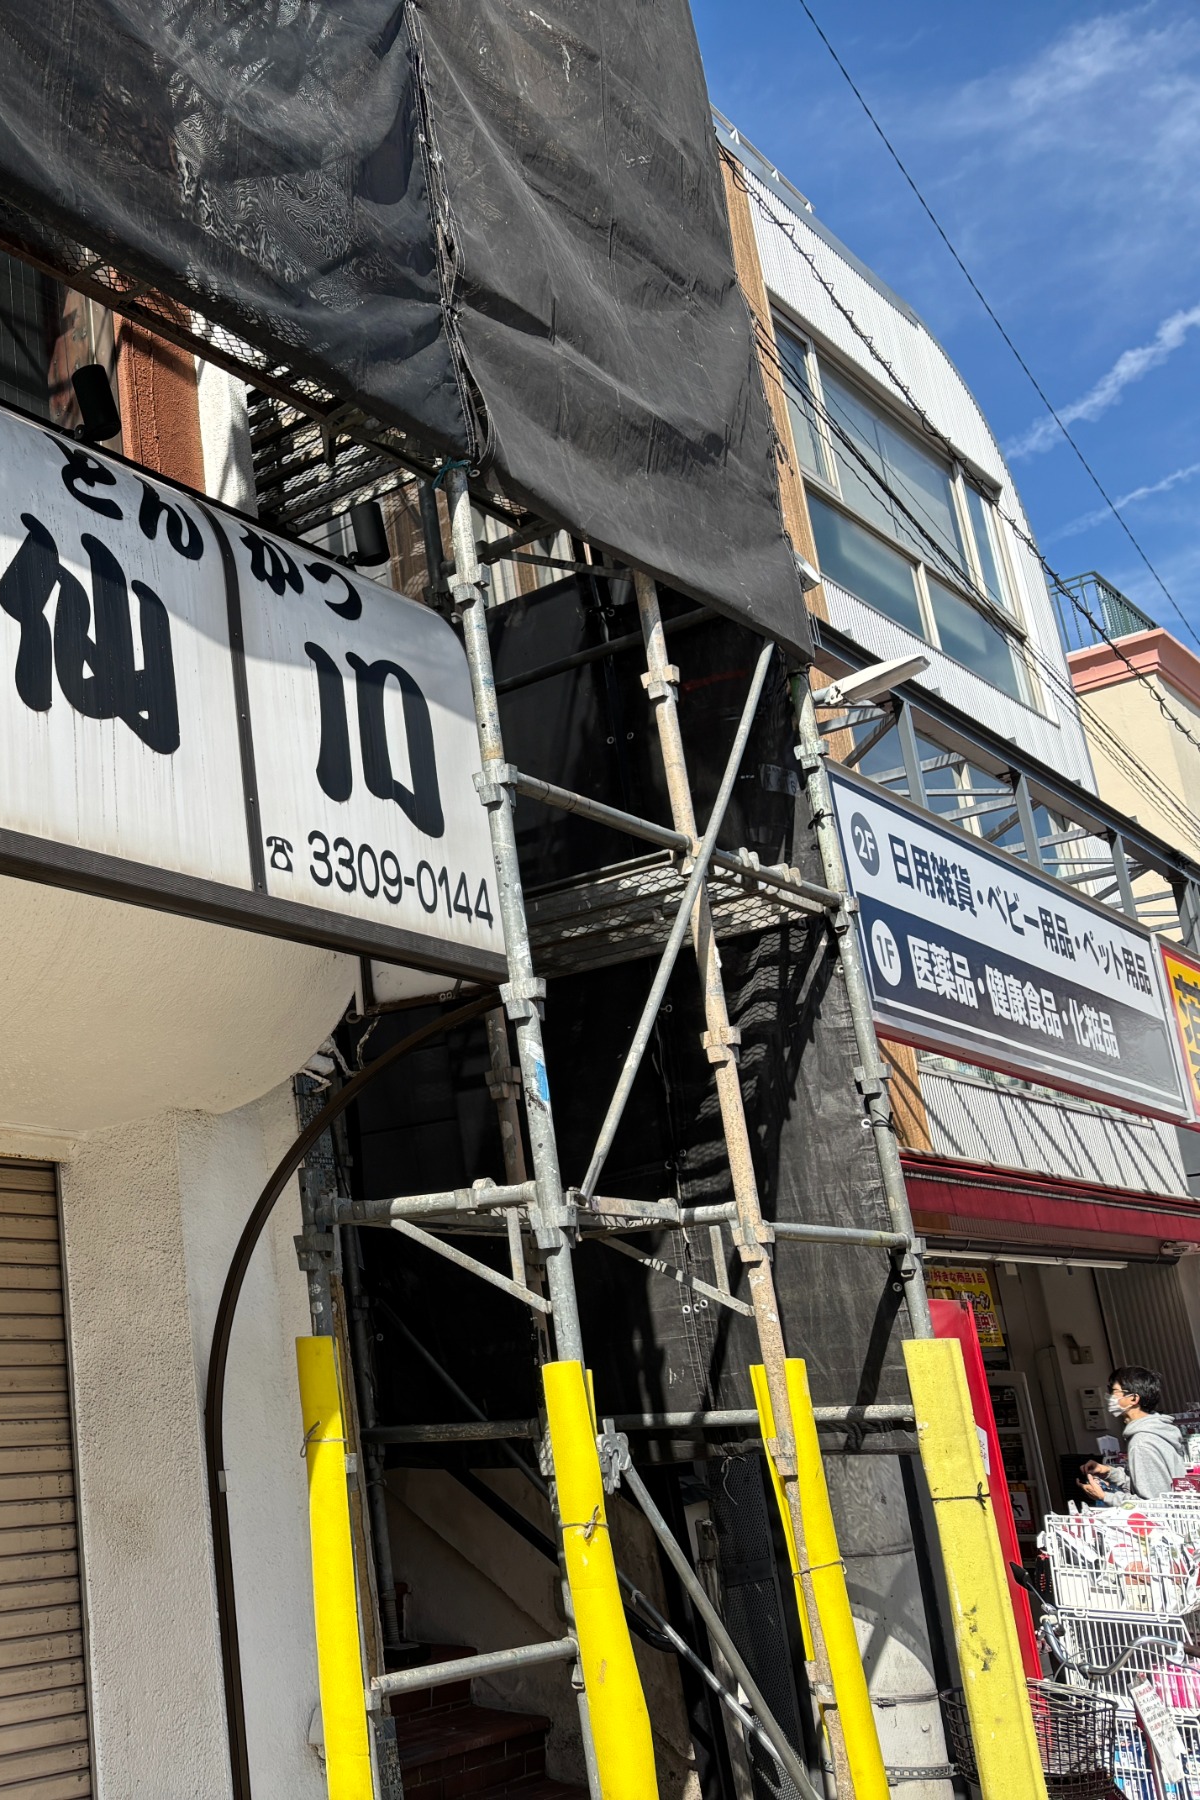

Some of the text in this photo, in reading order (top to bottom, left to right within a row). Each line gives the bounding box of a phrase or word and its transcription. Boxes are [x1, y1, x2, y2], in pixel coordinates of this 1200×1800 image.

[44, 432, 363, 620] とんかつ
[307, 830, 493, 928] 3309-0144
[854, 826, 875, 861] 2F
[876, 934, 895, 975] 1F
[888, 833, 1153, 997] 日用雑貨・ベビー用品・ペット用品
[907, 934, 1120, 1059] 医薬品・健康食品・化粧品
